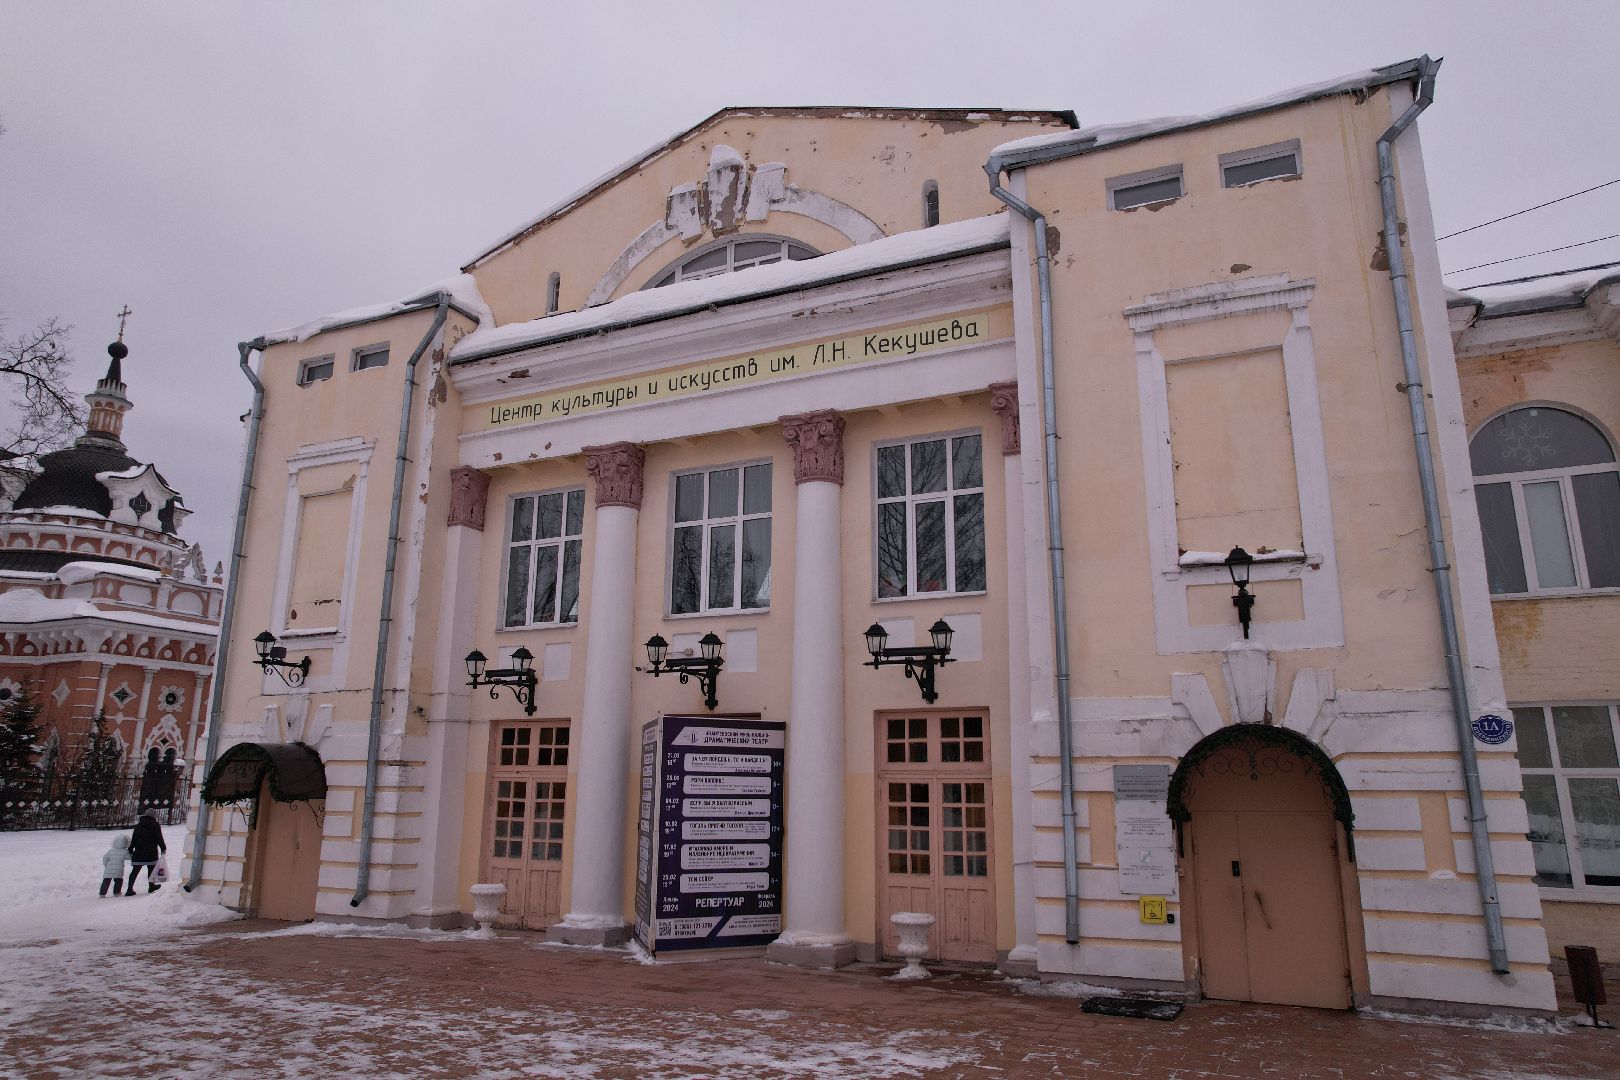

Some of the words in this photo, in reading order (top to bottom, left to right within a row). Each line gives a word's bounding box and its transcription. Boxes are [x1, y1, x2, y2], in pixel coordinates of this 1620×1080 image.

[490, 402, 542, 424] Центр
[551, 385, 638, 415] культуры
[648, 381, 658, 395] и
[668, 357, 758, 391] искусств
[769, 354, 800, 373] им.
[812, 340, 851, 365] Л.Н.
[864, 319, 980, 356] Кекушева
[695, 897, 745, 908] РЕПЕРТУАР
[758, 900, 774, 908] 2024
[662, 904, 679, 912] 2024
